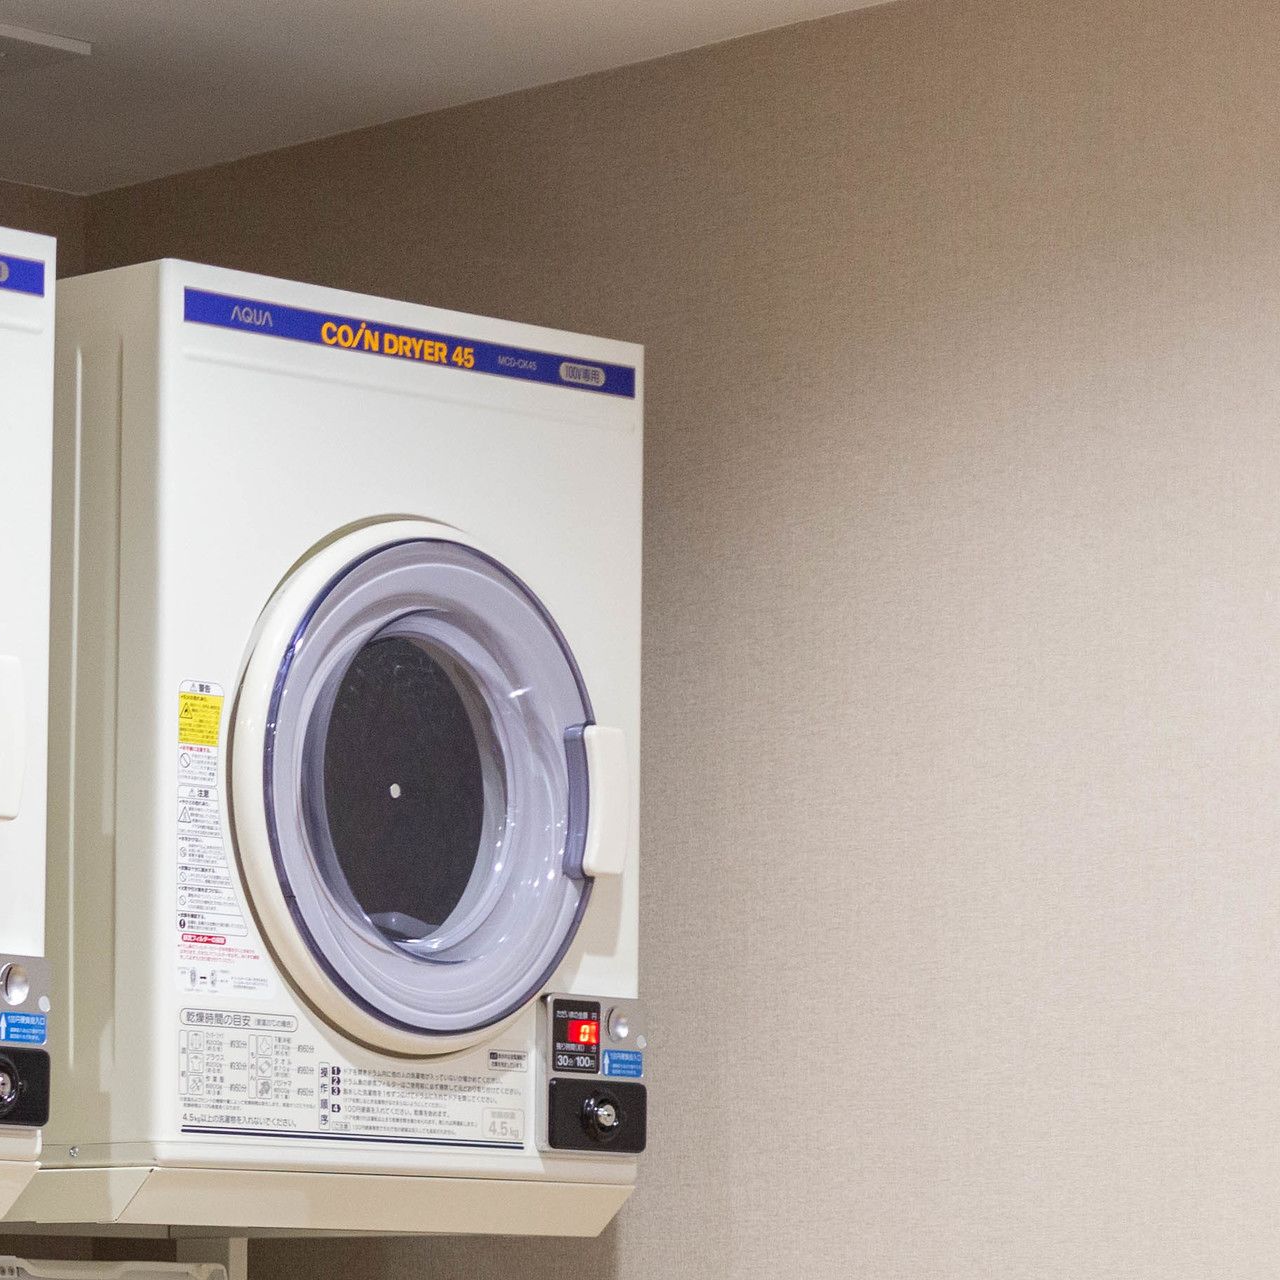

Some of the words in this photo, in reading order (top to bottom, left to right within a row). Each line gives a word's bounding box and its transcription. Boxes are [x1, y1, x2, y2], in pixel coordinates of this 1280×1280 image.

[230, 305, 273, 327] AQUA
[383, 333, 447, 365] DRYER
[452, 346, 474, 368] 45
[186, 1011, 251, 1027] 乾燥時間の目安
